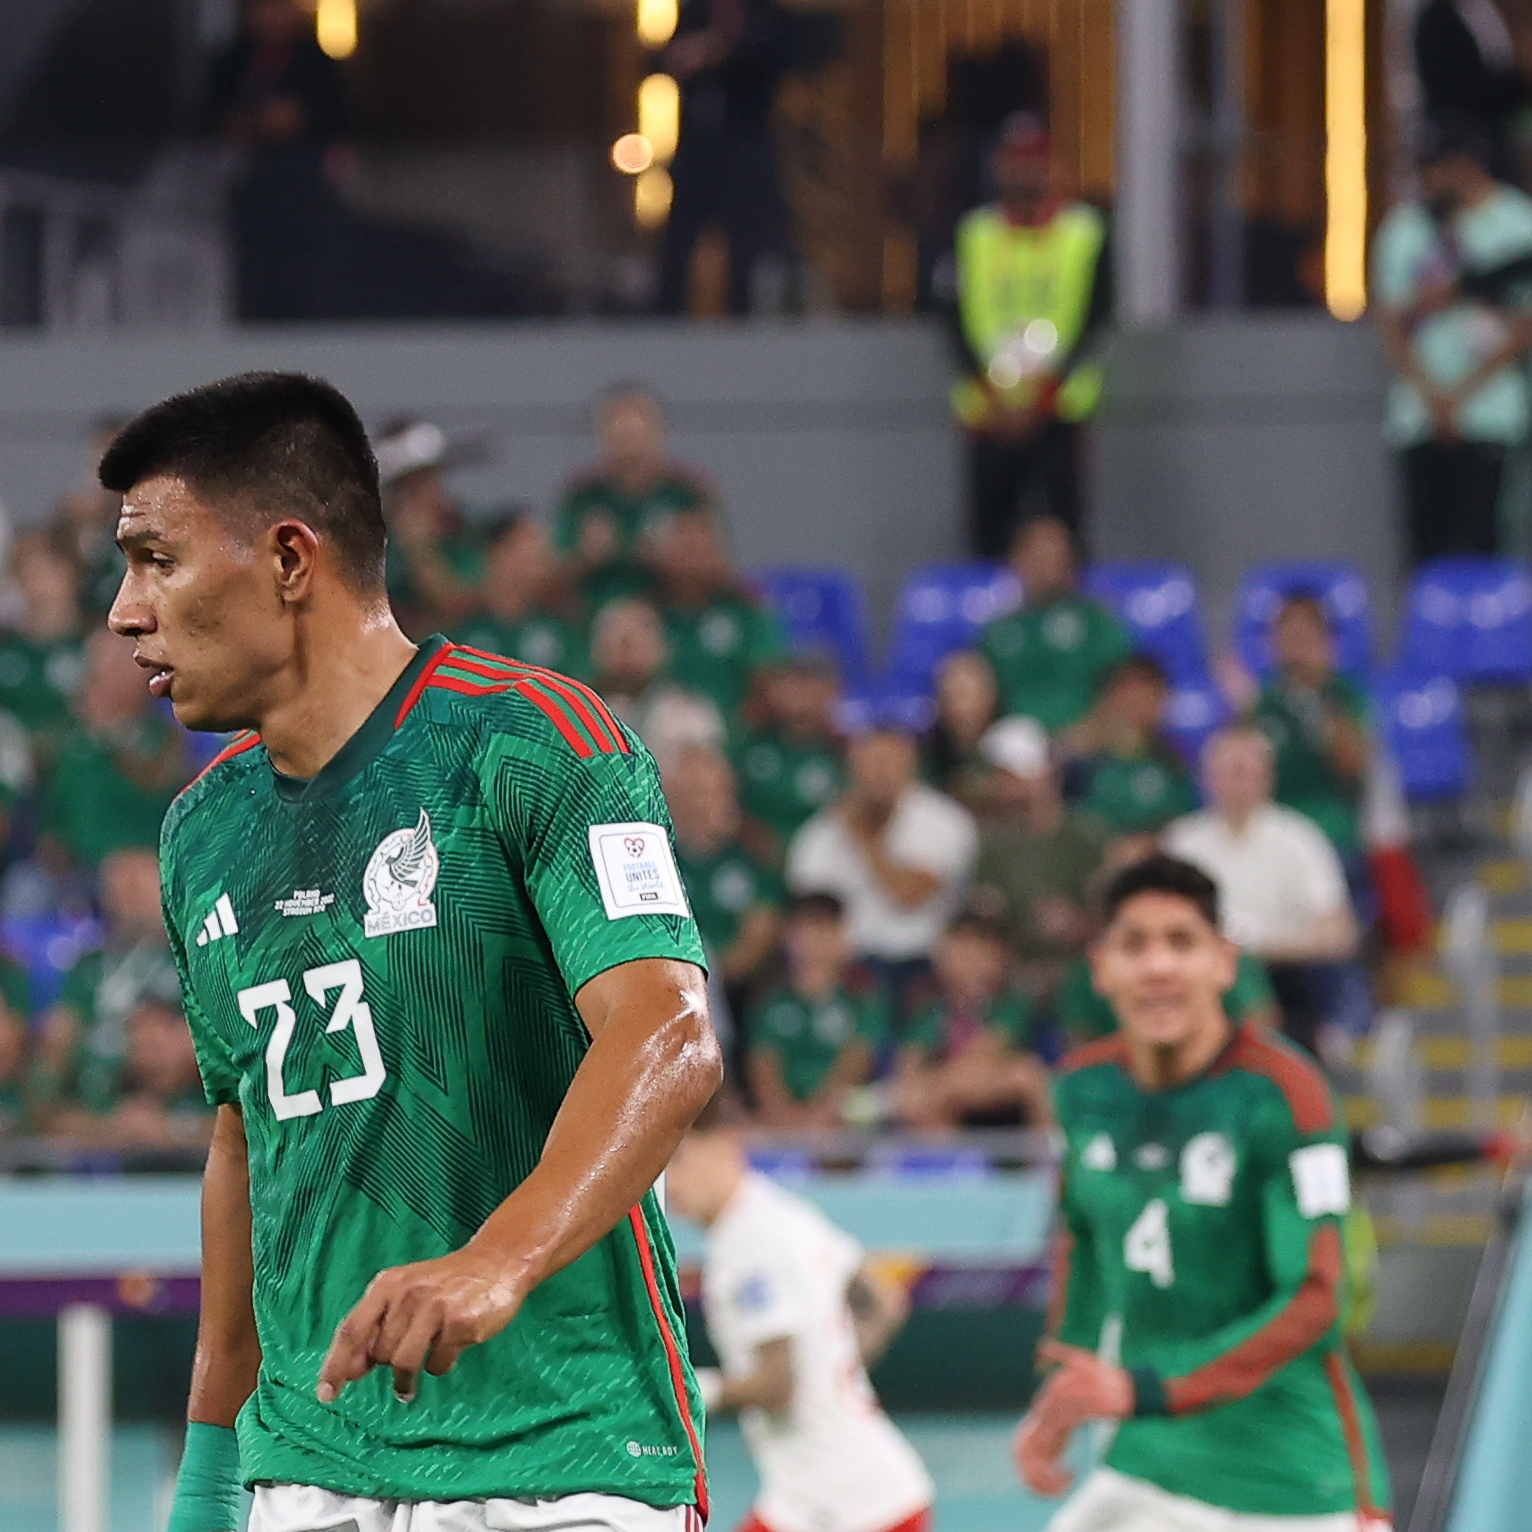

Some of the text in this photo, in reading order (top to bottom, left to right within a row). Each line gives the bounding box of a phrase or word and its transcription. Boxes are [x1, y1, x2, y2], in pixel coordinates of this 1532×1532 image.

[625, 870, 660, 883] UNITES
[237, 958, 387, 1121] 23
[1122, 1198, 1175, 1289] 4
